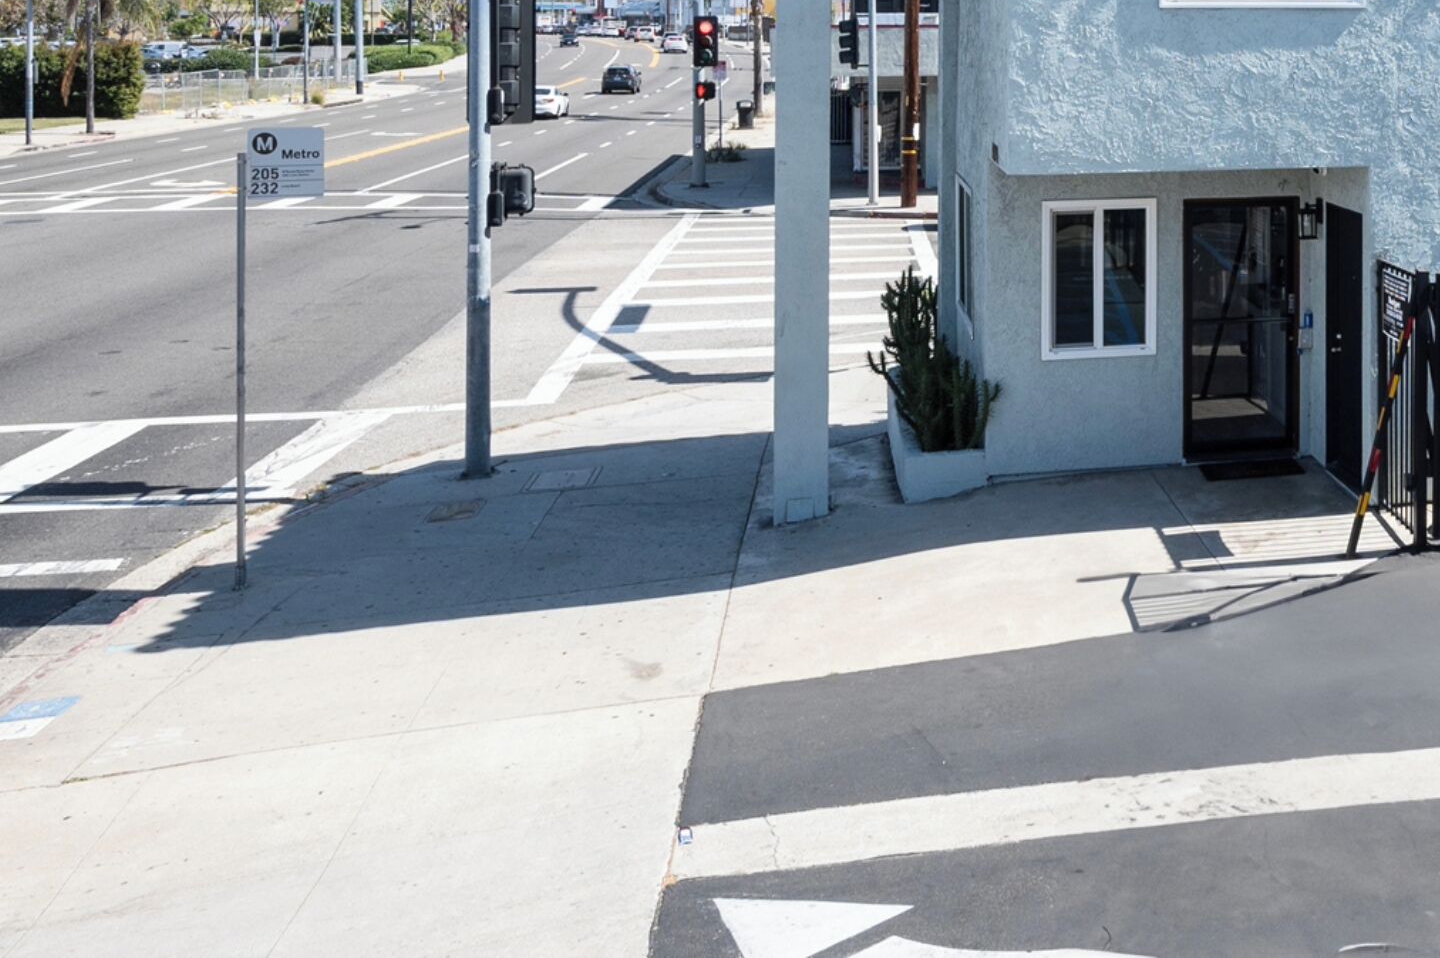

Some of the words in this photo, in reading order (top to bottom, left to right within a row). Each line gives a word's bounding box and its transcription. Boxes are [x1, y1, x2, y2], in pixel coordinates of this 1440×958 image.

[281, 149, 320, 159] Metro
[252, 168, 279, 180] 205
[251, 182, 278, 194] 232
